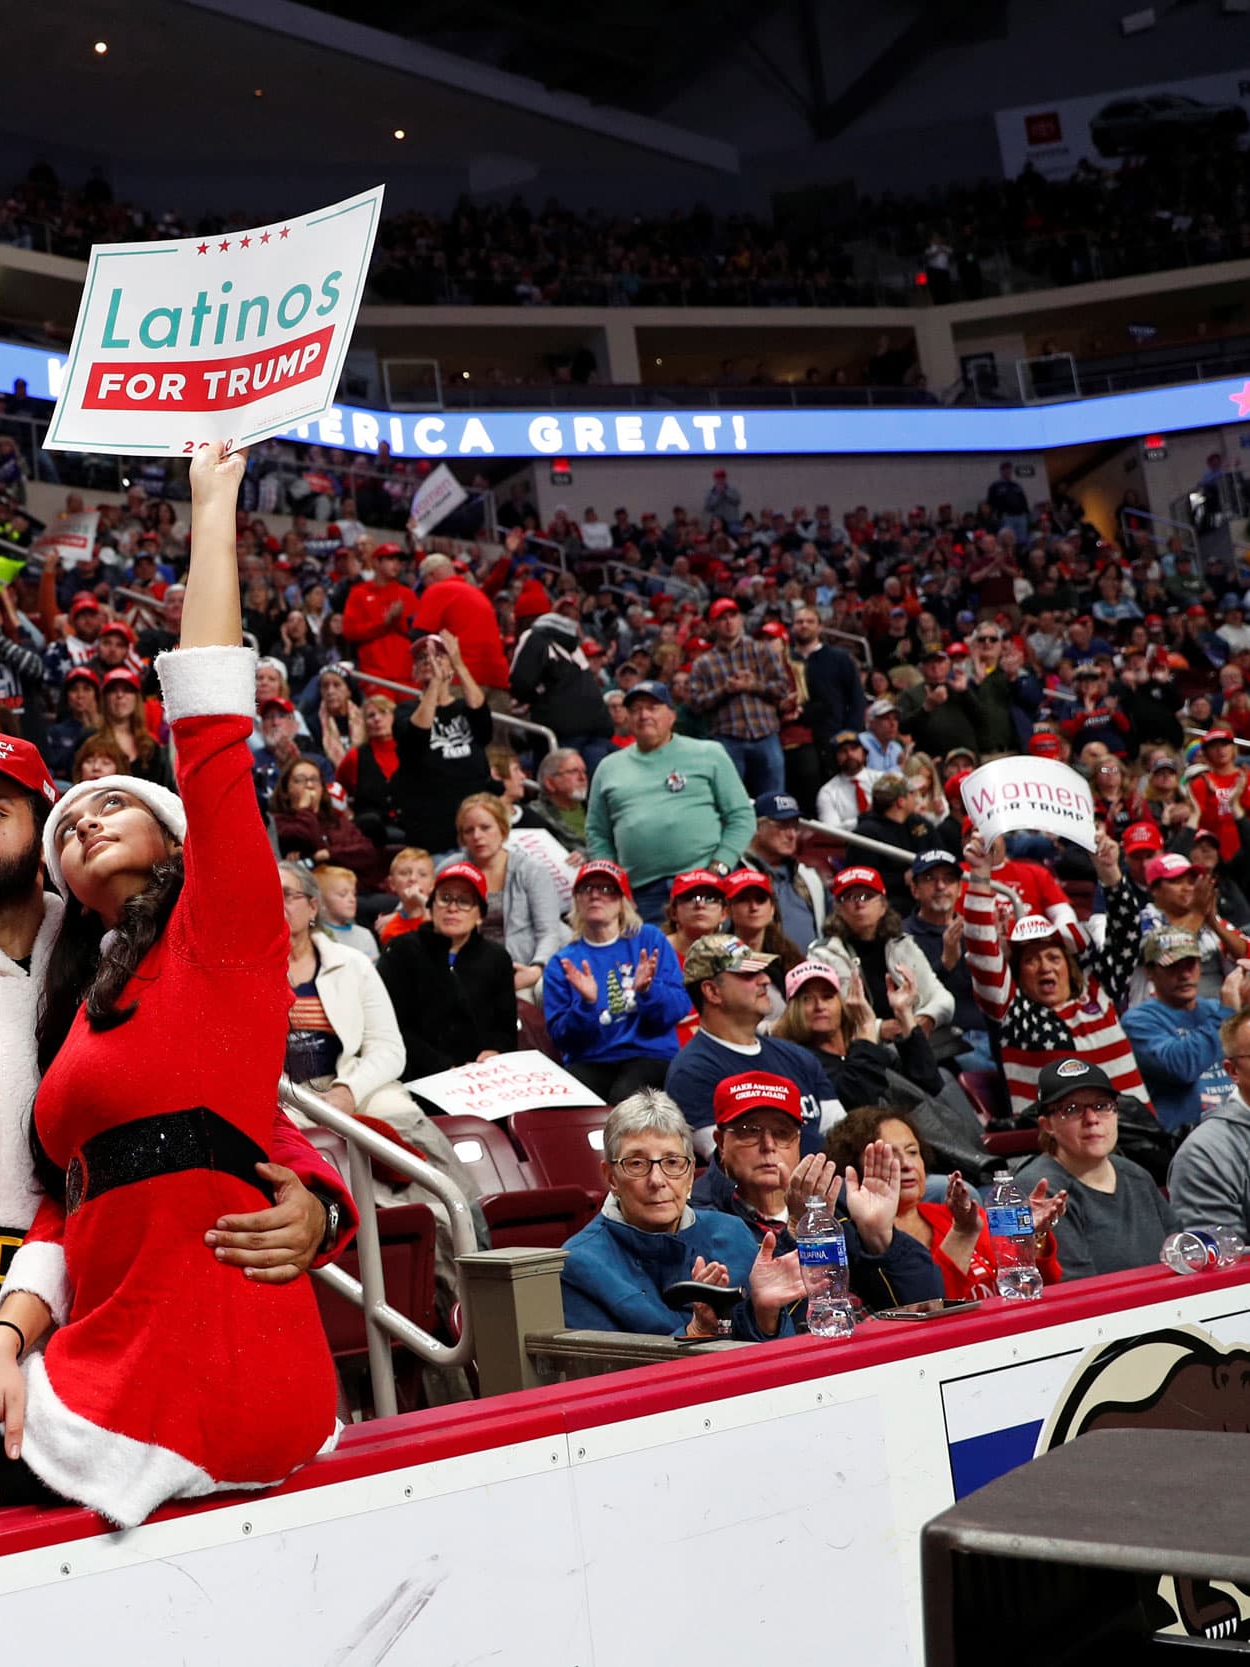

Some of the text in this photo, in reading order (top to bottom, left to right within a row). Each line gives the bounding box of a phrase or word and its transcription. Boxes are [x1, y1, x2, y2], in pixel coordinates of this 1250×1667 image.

[101, 270, 342, 349] Latinos
[97, 373, 186, 401] FOR
[203, 342, 321, 400] TRUMP
[297, 408, 495, 453] ERICA
[528, 415, 748, 453] GREAT!
[182, 438, 233, 454] 20
[972, 781, 1091, 815] Women
[987, 801, 1084, 821] FOR TRUMP
[465, 1084, 574, 1111] to 88022
[730, 1083, 790, 1095] MAKE AMERICA
[735, 1090, 787, 1101] GREAT AGAIN
